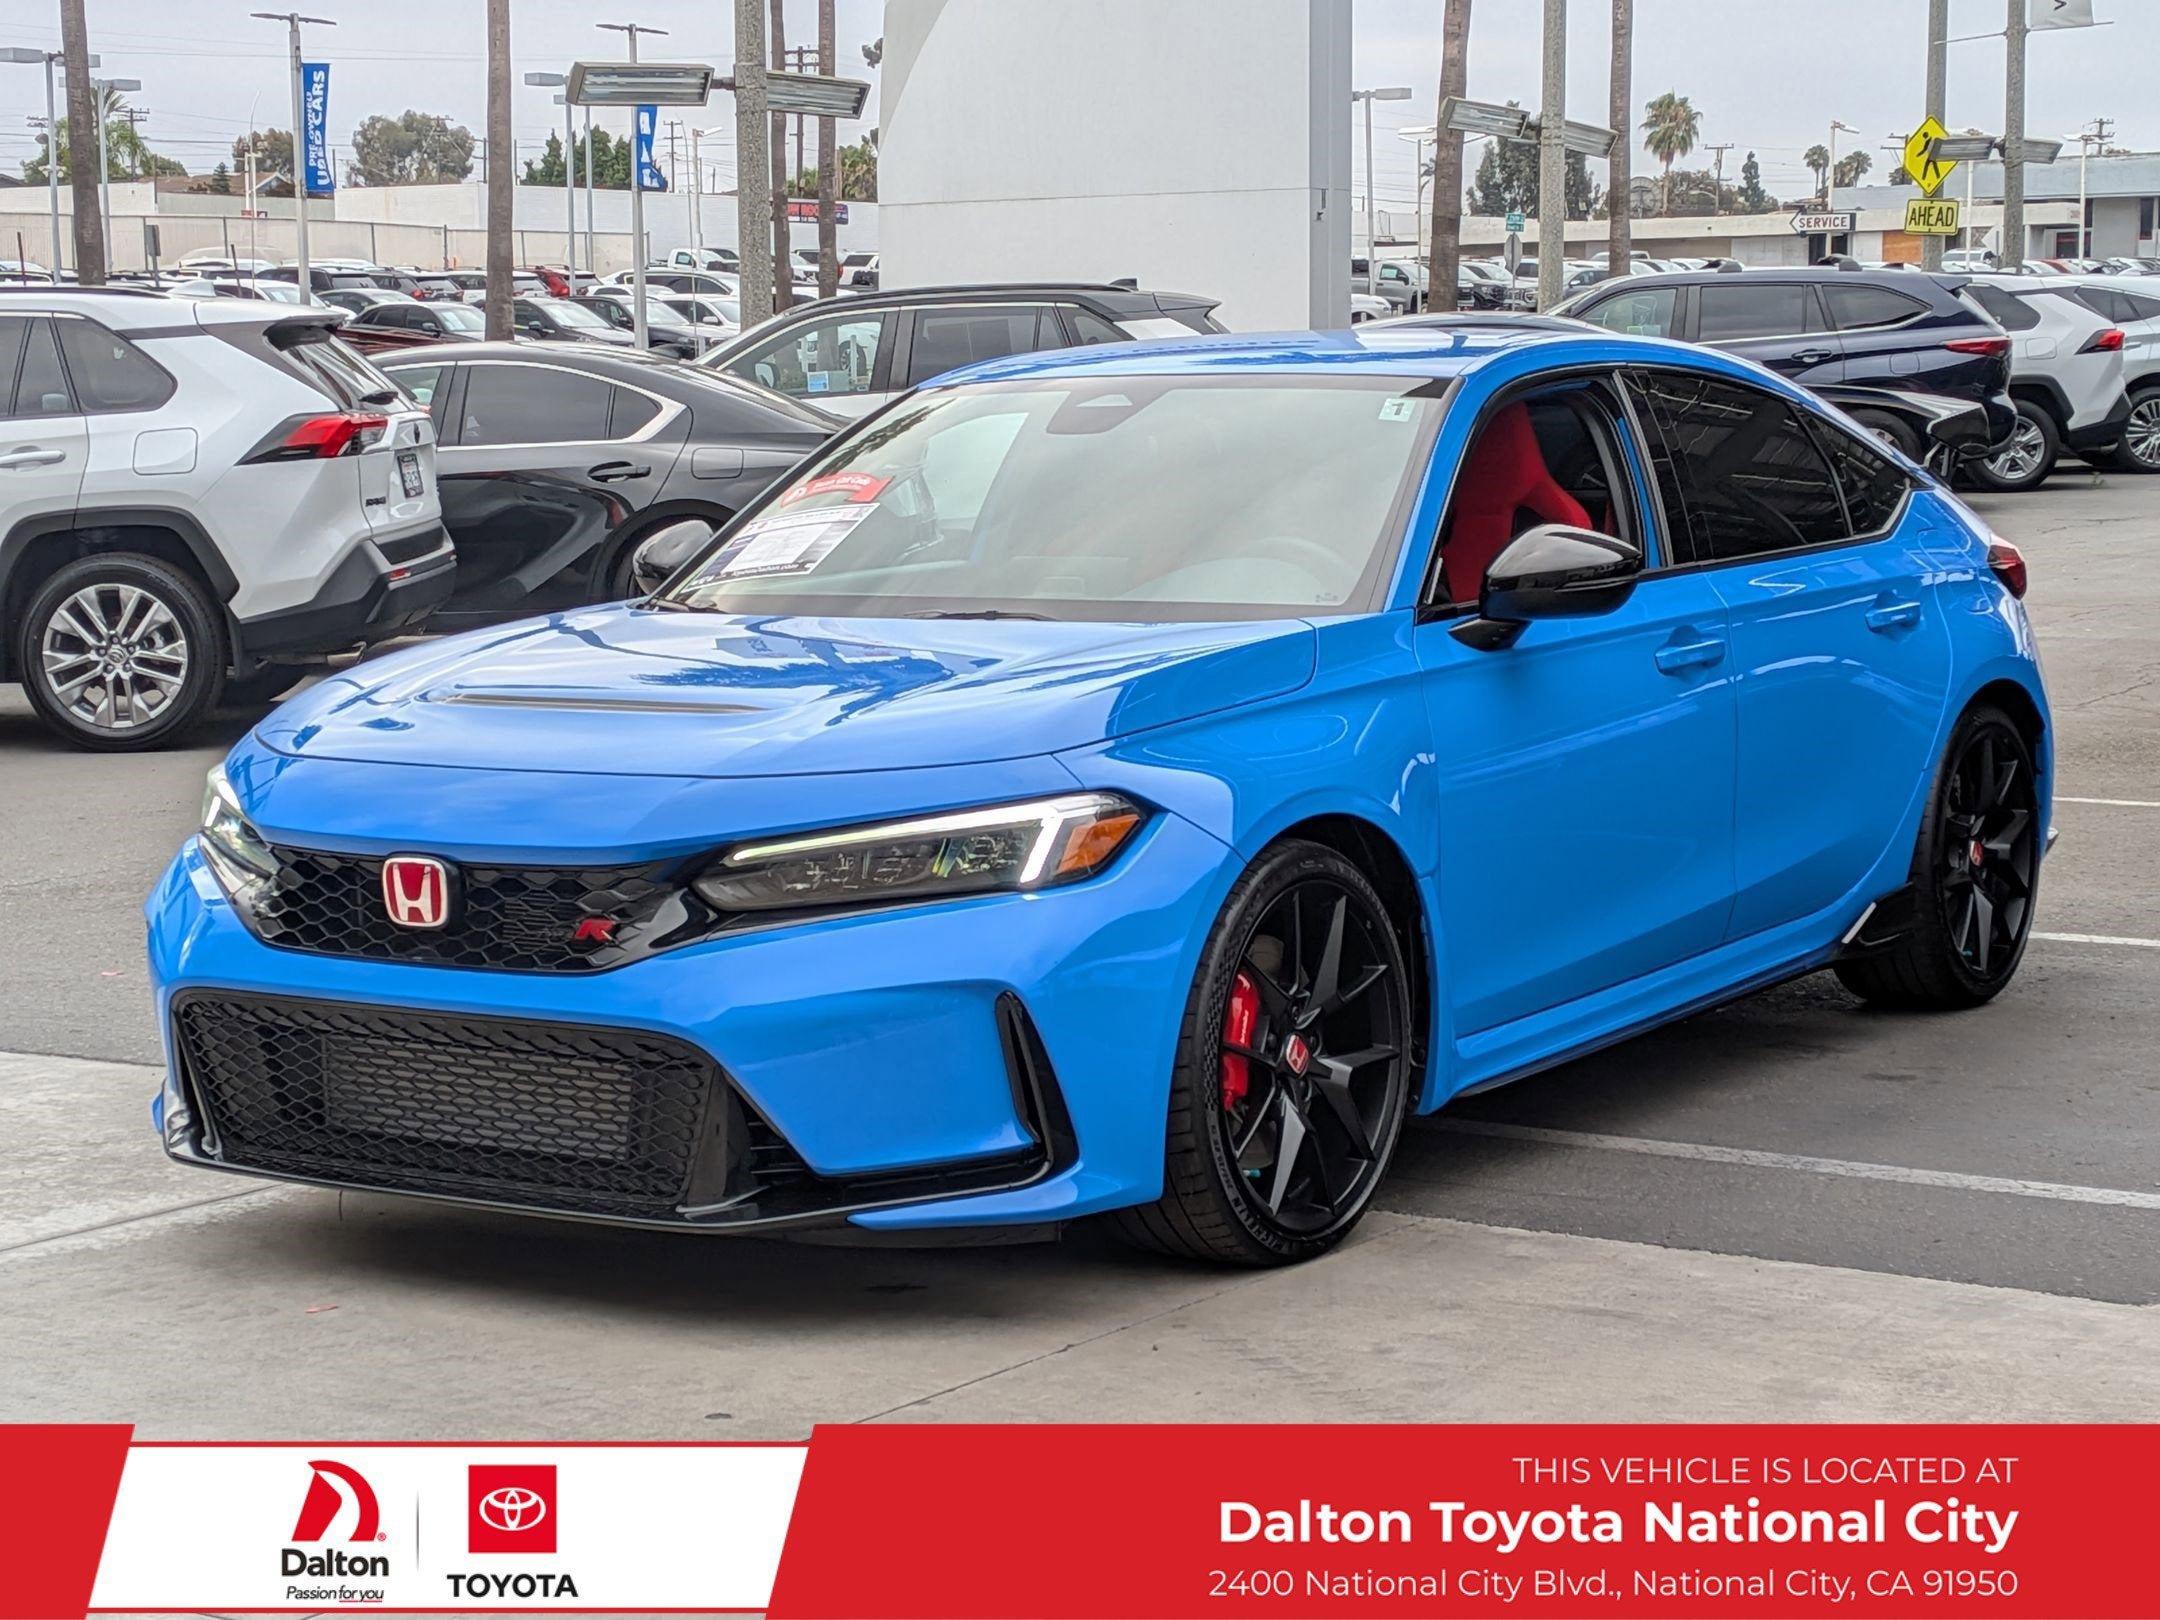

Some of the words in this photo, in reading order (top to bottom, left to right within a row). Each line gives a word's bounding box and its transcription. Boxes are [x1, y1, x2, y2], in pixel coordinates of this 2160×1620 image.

[312, 70, 325, 126] CARS
[314, 130, 330, 185] USED
[1799, 216, 1847, 229] SERVICE
[1909, 206, 1955, 227] AHEAD
